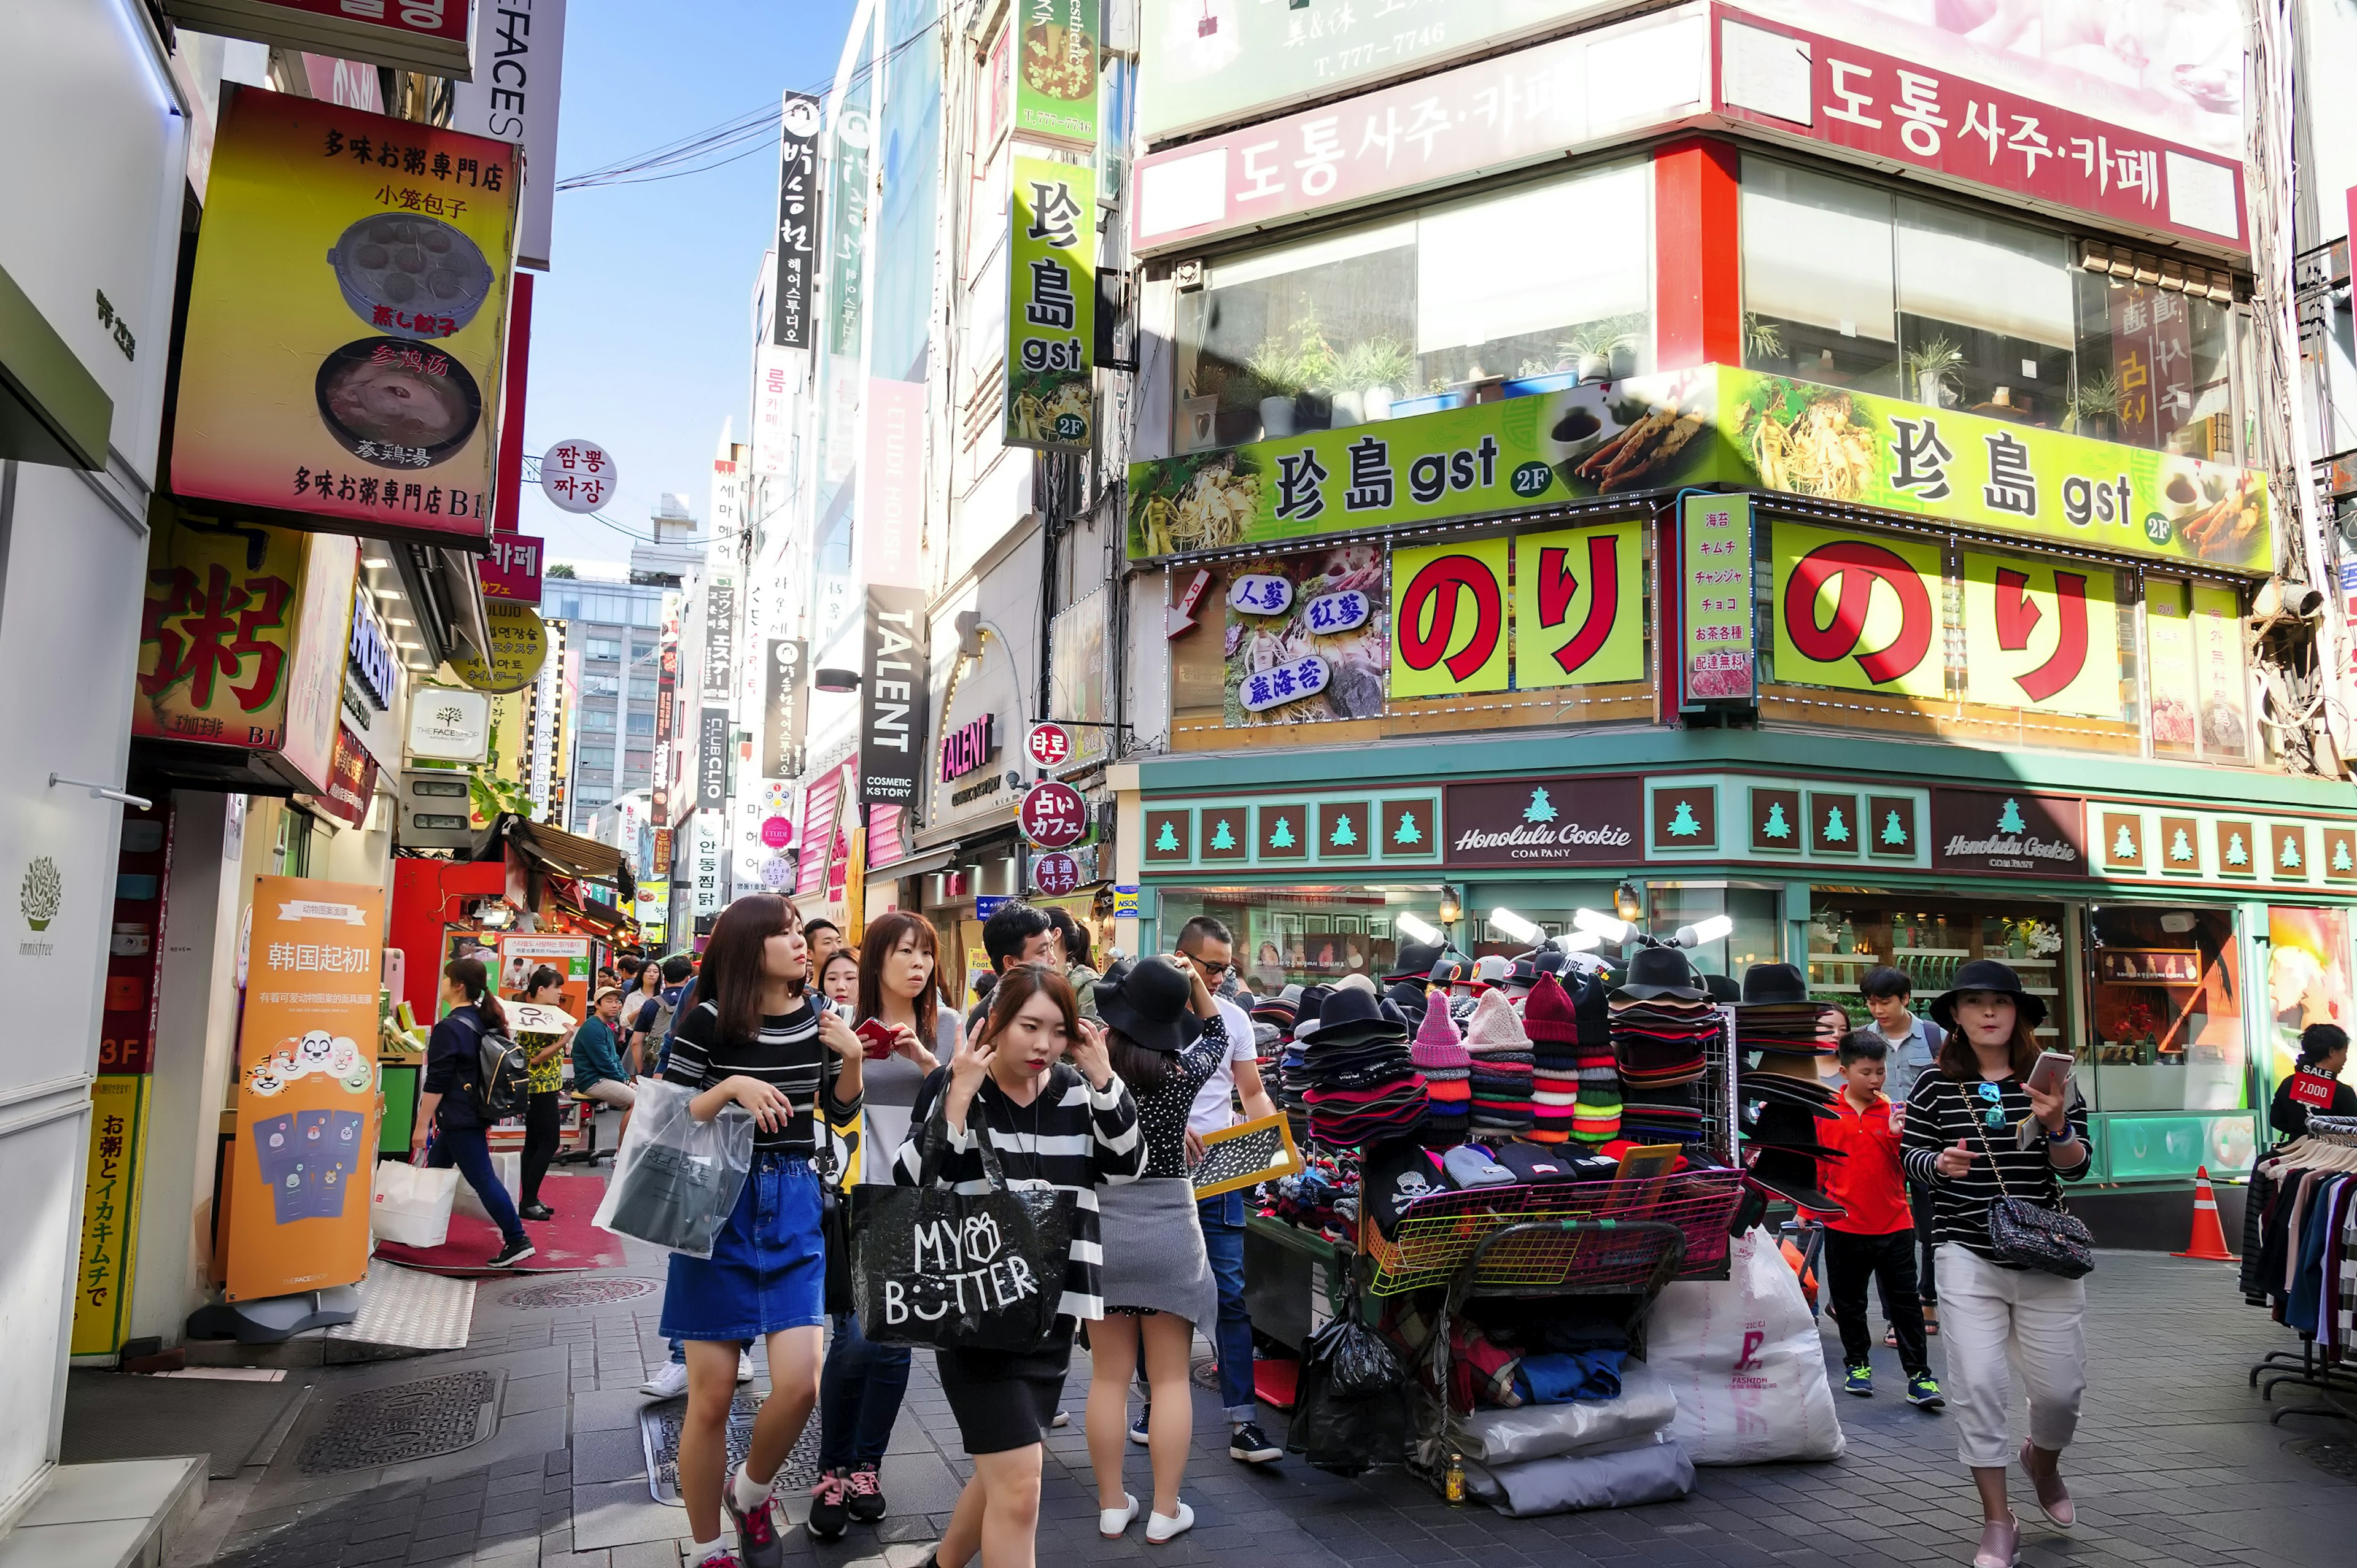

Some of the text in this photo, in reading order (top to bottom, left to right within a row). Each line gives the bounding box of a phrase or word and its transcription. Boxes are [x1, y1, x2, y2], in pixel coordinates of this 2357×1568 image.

[1822, 57, 1948, 158] 도통
[323, 128, 504, 193] 多味お粥専門店
[1235, 115, 1346, 203] 도통
[374, 184, 468, 219] 小笼包子
[781, 142, 814, 252] 박승철
[371, 304, 459, 338] 蒸し餃子
[1021, 338, 1082, 373] gst
[1058, 419, 1083, 435] 2F
[885, 407, 906, 481] ETUDE
[555, 445, 605, 472] 짬뽕
[1409, 436, 1498, 503] gst
[293, 465, 443, 516] 多味お粥専門店
[554, 477, 605, 504] 짜장
[1516, 469, 1549, 492] 2F
[2063, 474, 2131, 527] gst
[718, 485, 734, 560] 세마헤어
[1705, 511, 1730, 530] 海苔
[2146, 518, 2170, 539] 2F
[1699, 539, 1737, 557] キムチ
[1693, 568, 1744, 587] チャンジャ
[1398, 534, 1619, 685] のり
[1700, 597, 1738, 613] チョコ
[2157, 604, 2174, 616] のり
[1694, 624, 1744, 643] お茶各種
[1782, 539, 2088, 703] のり
[1693, 654, 1745, 673] 配達無料
[874, 608, 914, 752] TALENT
[174, 714, 276, 746] 珈琲 B1
[416, 727, 480, 738] THEFACESHOP
[1032, 731, 1066, 756] 타로
[941, 713, 989, 783] TALENT
[535, 730, 552, 805] Kitchen
[867, 776, 912, 788] COSMETIC
[867, 786, 912, 798] KSTORY
[1035, 790, 1075, 815] 占い
[1031, 817, 1080, 837] カフェ
[1455, 822, 1631, 852] Honolulu Cookie
[1511, 849, 1571, 859] COMPANY
[1944, 834, 2076, 862] Honolulu Cookie
[698, 841, 717, 906] 안동찜닭
[1042, 859, 1073, 875] 道通
[1989, 858, 2034, 870] COMPANY
[1042, 875, 1075, 892] 사주
[303, 905, 349, 917] 动物图案面膜
[18, 937, 54, 958] innisfree
[267, 941, 370, 974] 韩国起初!
[99, 1039, 139, 1065] 3F
[2302, 1065, 2332, 1079] SALE
[87, 1114, 125, 1307] お粥とイカキムチで
[914, 1222, 966, 1274] MY
[282, 1272, 328, 1286] THEFACESHOP
